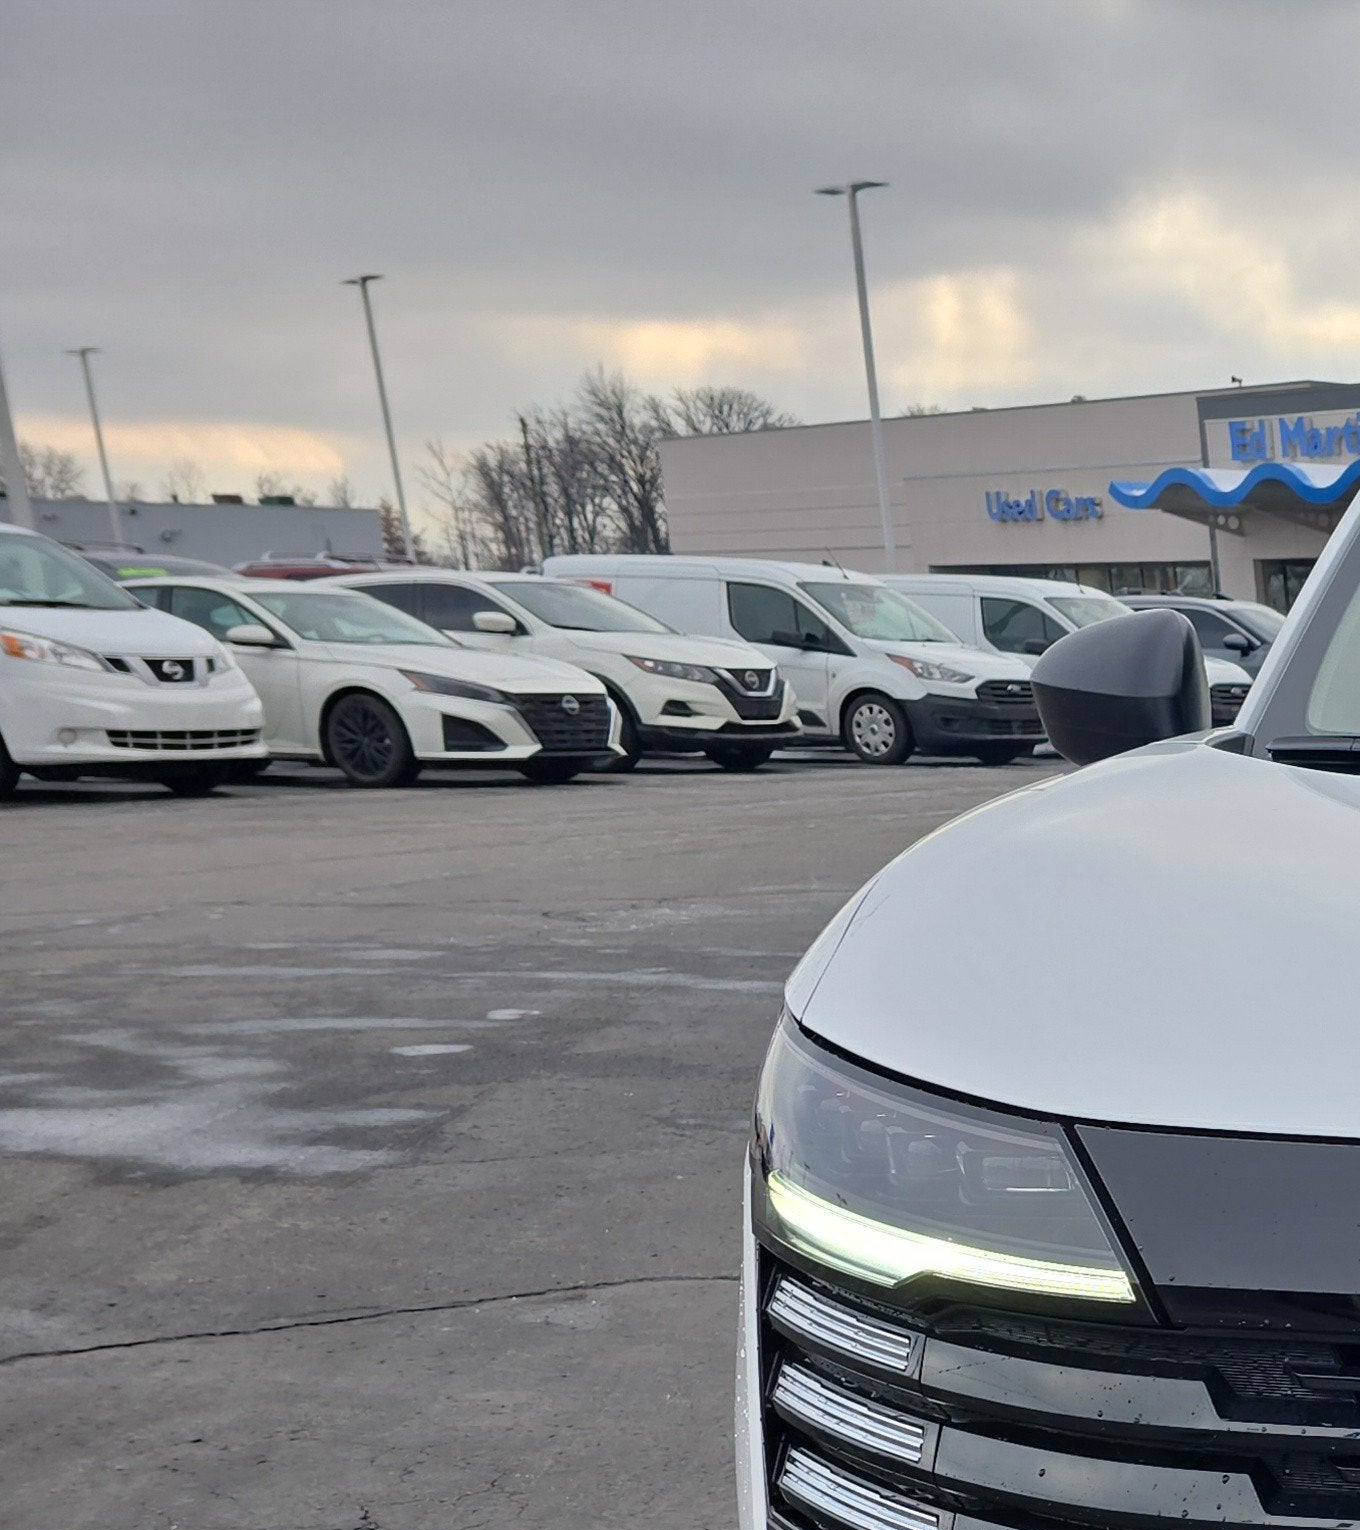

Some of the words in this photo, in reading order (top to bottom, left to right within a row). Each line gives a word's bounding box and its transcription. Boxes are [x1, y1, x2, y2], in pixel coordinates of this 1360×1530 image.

[1228, 418, 1268, 461] Ed
[985, 489, 1040, 521] Used
[1045, 489, 1101, 521] Cars
